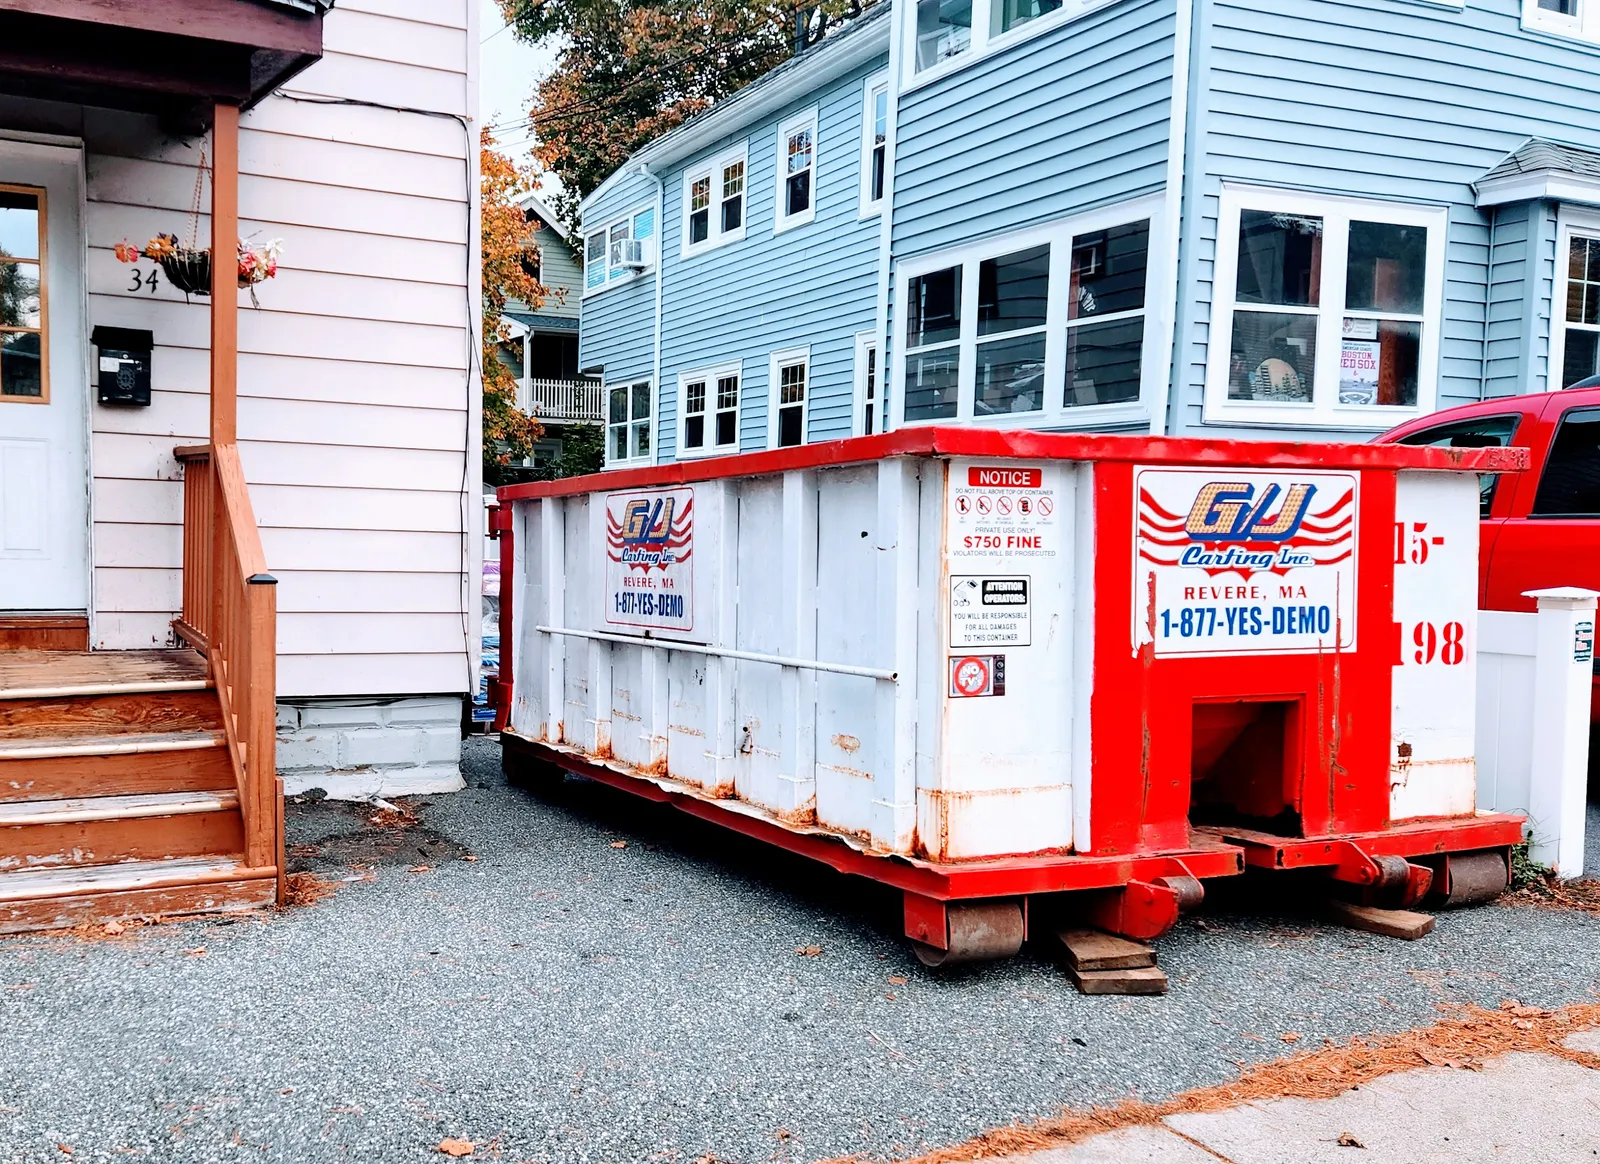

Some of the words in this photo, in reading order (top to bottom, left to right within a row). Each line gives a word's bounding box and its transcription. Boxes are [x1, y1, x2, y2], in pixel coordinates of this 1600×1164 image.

[127, 268, 159, 294] 34
[1342, 350, 1372, 359] BOSTON
[1358, 360, 1376, 369] SOX
[980, 470, 1031, 485] NOTICE
[964, 536, 1001, 548] $750
[1007, 536, 1042, 548] FINE
[622, 548, 660, 564] Carting
[1181, 546, 1274, 567] Carting
[624, 577, 656, 589] REVERE,
[662, 578, 674, 588] MA
[986, 582, 1023, 591] ATTENTION
[1184, 586, 1267, 601] REVERE,
[1279, 586, 1307, 599] MA
[615, 592, 683, 618] 1-877-YES-DEMO
[1160, 605, 1330, 637] 1-877-YES-DEMO
[1392, 622, 1464, 666] 198
[961, 665, 980, 675] NO
